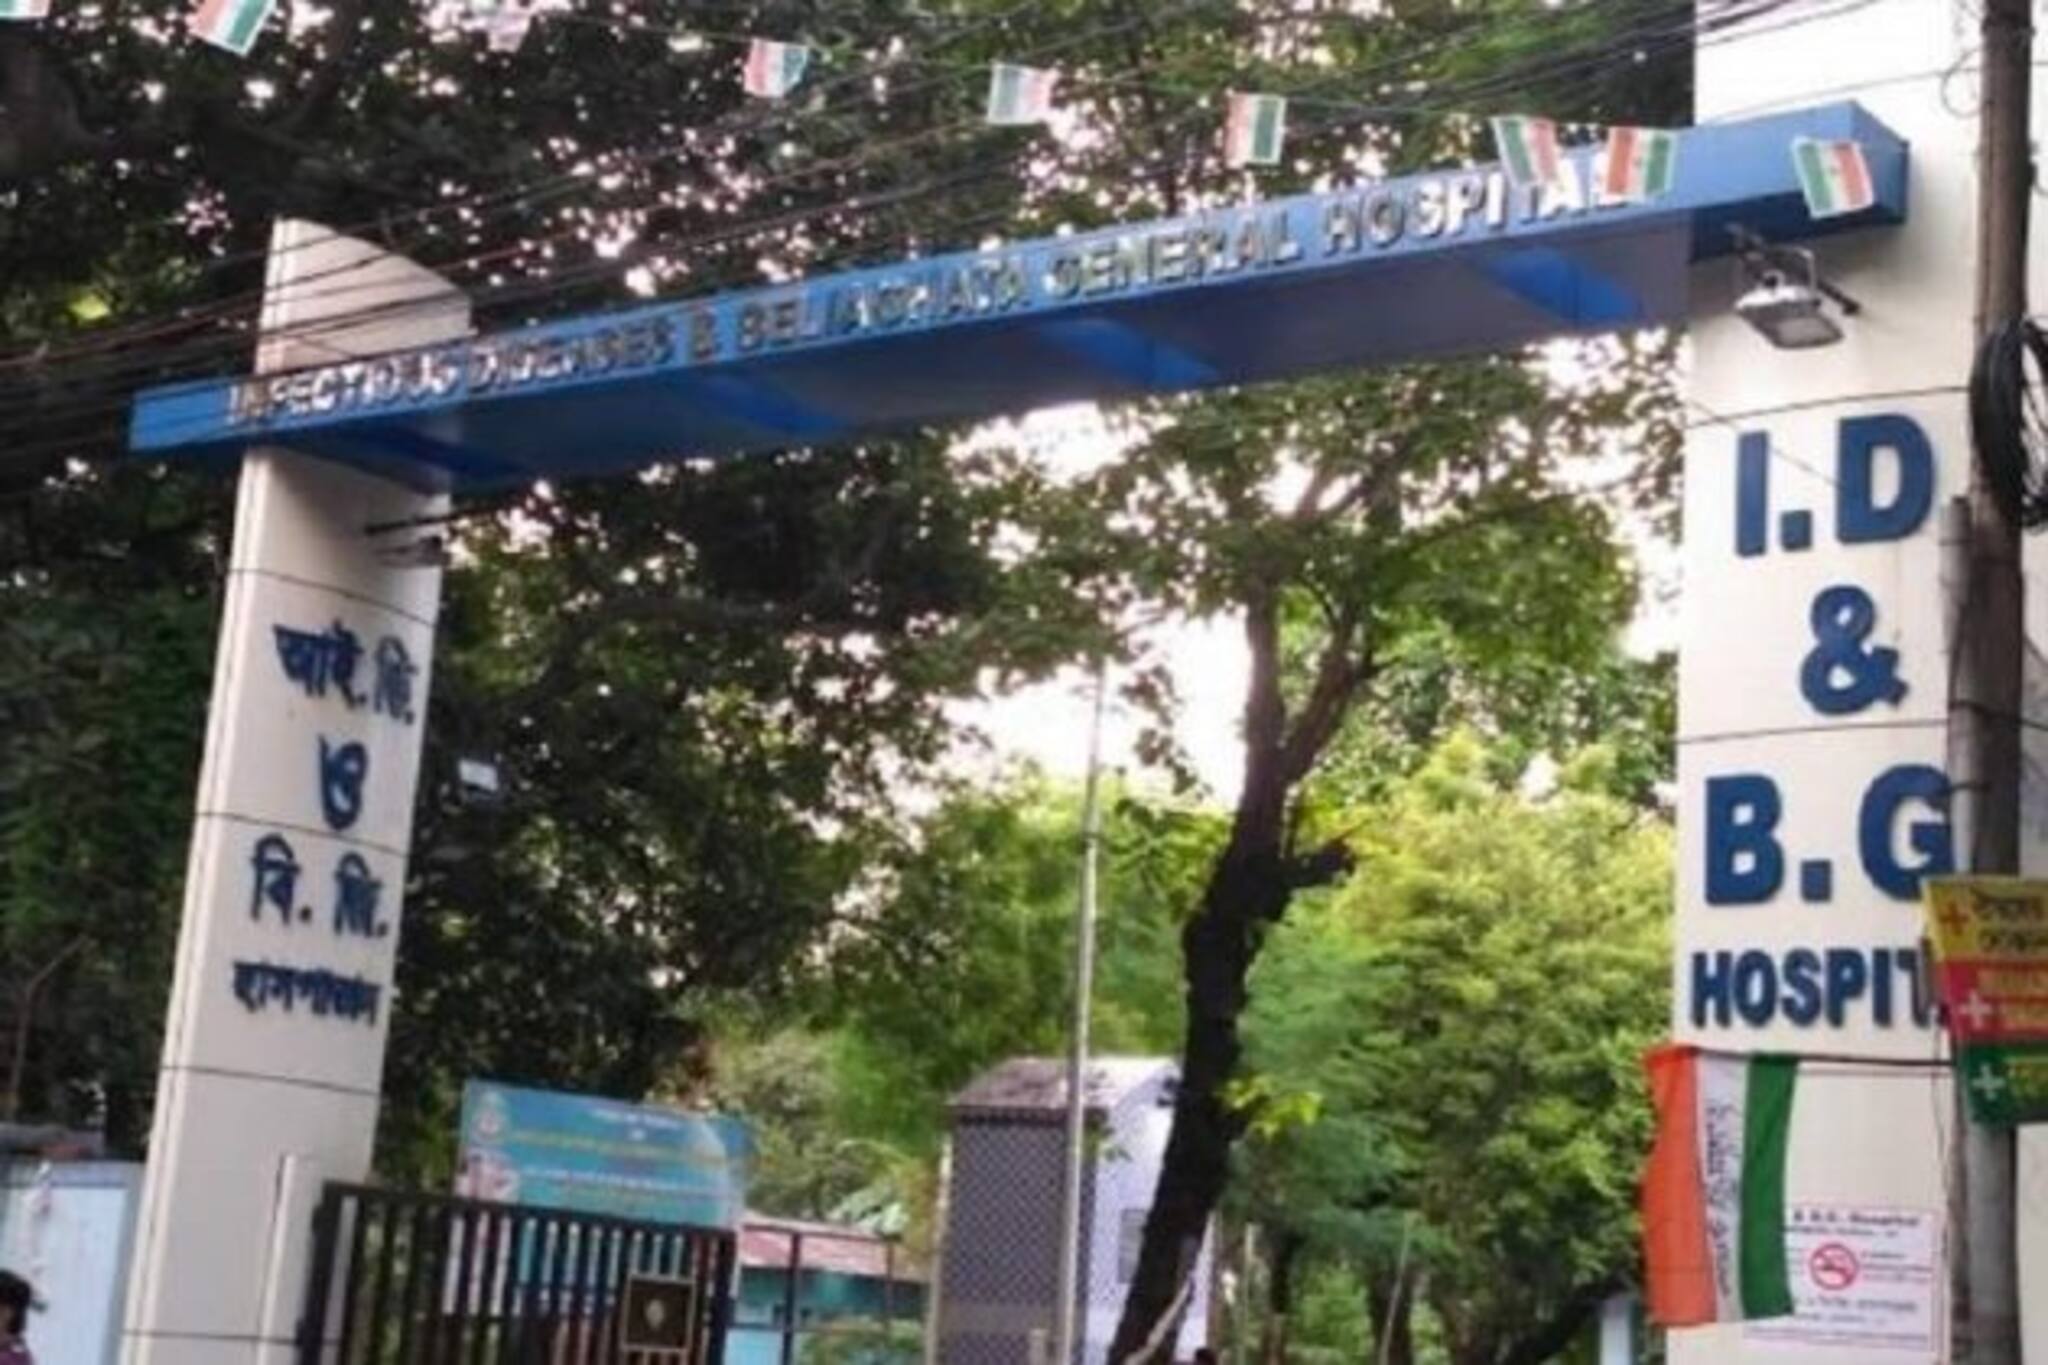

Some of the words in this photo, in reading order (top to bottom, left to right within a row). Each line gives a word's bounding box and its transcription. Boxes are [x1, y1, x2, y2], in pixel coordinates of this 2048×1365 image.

[1042, 206, 1304, 299] GENERAL
[1735, 413, 1935, 559] I.D
[1799, 584, 1910, 716] &
[317, 733, 369, 832] ও
[1703, 763, 1955, 907] B.G
[1689, 946, 1950, 1030] HOSPIT
